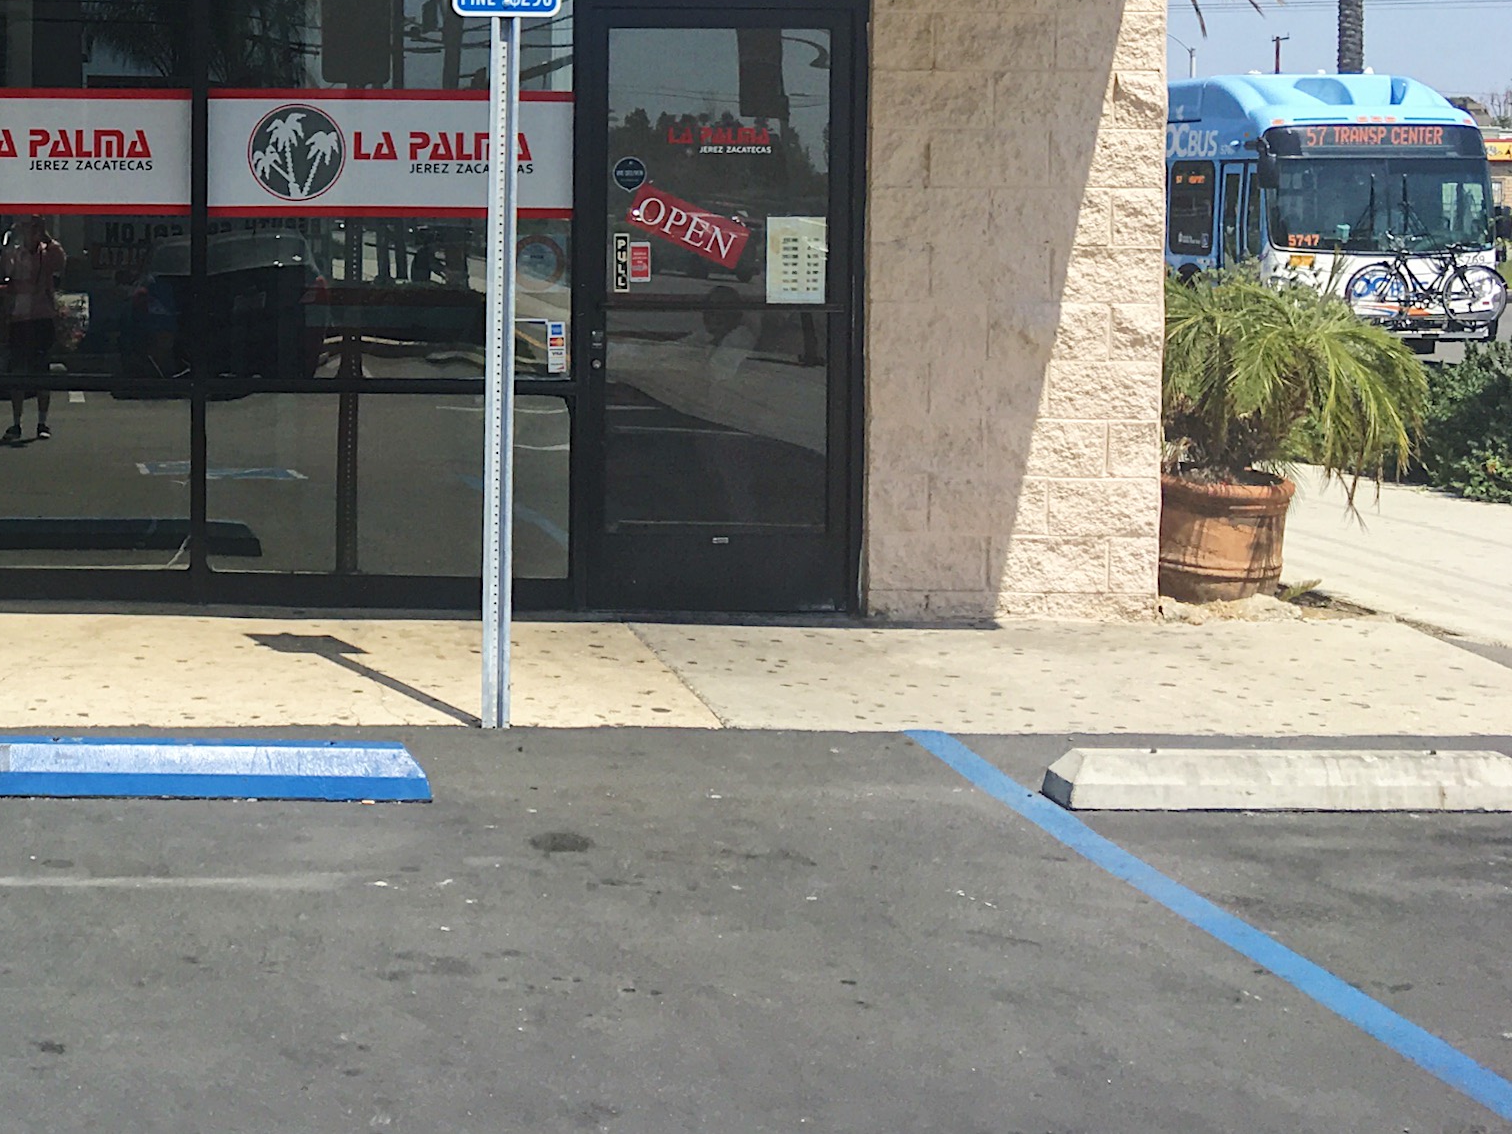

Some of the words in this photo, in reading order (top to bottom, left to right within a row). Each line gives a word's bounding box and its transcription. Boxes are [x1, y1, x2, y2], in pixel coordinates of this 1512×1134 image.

[29, 129, 152, 158] PALMA
[668, 126, 694, 144] LA
[700, 127, 771, 145] PALMA
[1306, 126, 1327, 146] 57
[1333, 126, 1387, 145] TRANSP
[1391, 126, 1444, 145] CENTER
[353, 131, 398, 160] LA
[699, 146, 724, 154] JEREZ
[726, 146, 772, 154] ZACATECAS
[29, 160, 69, 171] JEREZ
[75, 160, 154, 171] ZACATECAS
[409, 163, 449, 174] JEREZ
[456, 163, 534, 174] ZACAAS
[639, 197, 738, 259] OPEN
[1287, 233, 1320, 247] 5747
[616, 239, 627, 287] PULL
